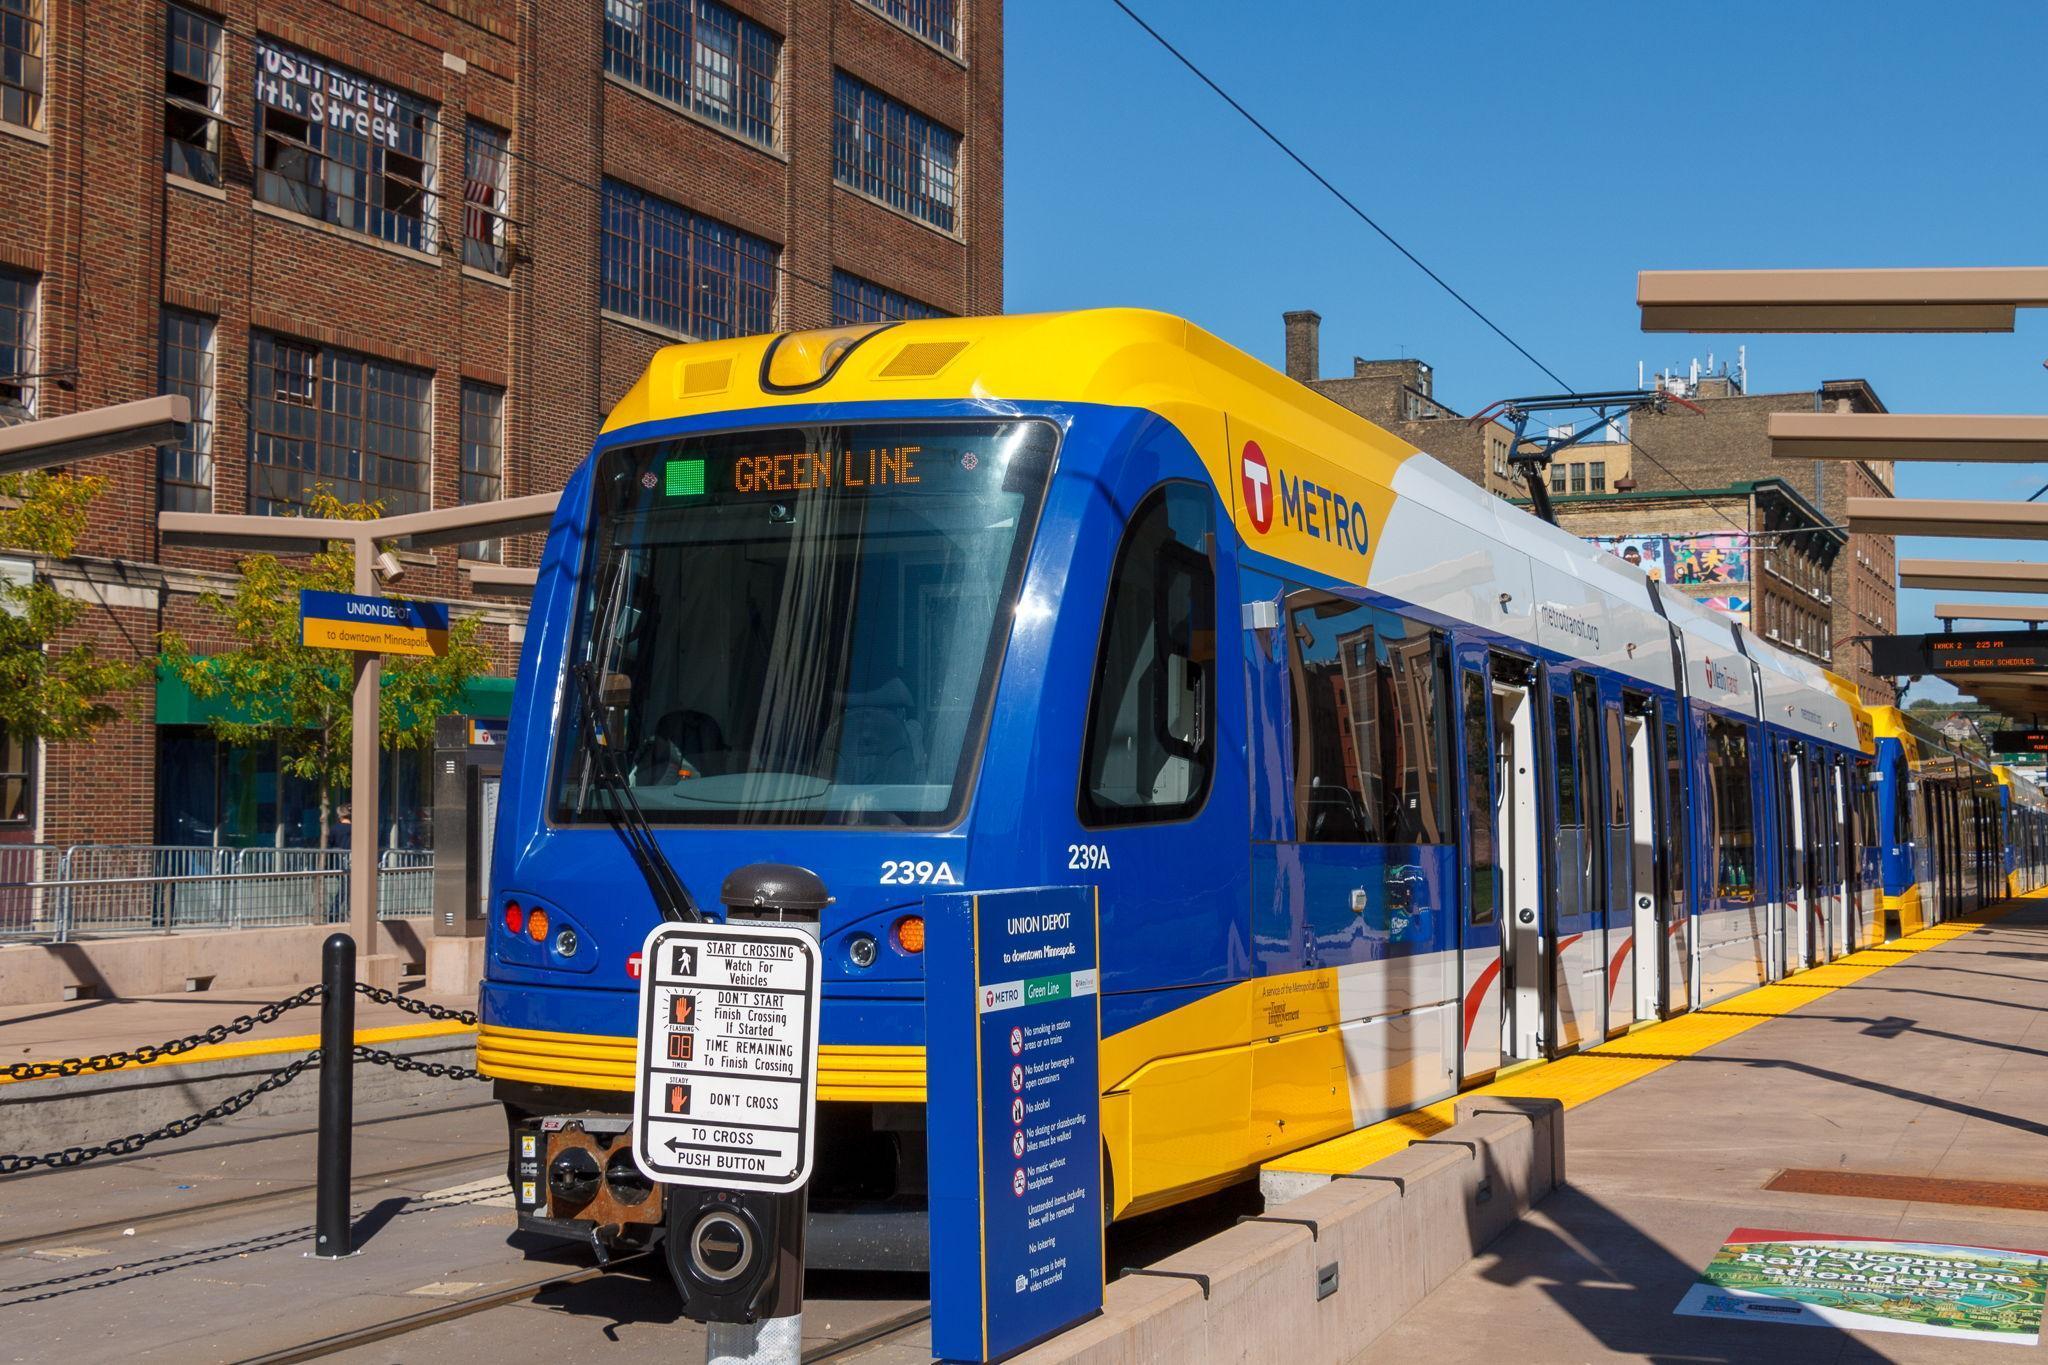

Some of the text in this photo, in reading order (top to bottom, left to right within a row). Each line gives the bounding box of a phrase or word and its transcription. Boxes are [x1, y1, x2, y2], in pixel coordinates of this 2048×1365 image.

[311, 92, 399, 148] Street
[735, 446, 921, 492] GREEN LINE
[1279, 468, 1369, 556] METRO
[347, 602, 411, 620] UNION DEPOT
[1541, 605, 1600, 650] metrotransit.org
[327, 630, 429, 651] to downtown Minneapolis
[1068, 844, 1111, 870] 239A
[880, 860, 956, 885] 239A
[1007, 912, 1071, 935] UNION DEPOT
[706, 941, 794, 959] START CROSSING
[1003, 942, 1076, 963] to downtown Minneapolis
[725, 958, 774, 973] Watch For
[730, 972, 768, 986] Vehicles
[718, 991, 785, 1007] DON'T START
[995, 989, 1019, 1003] METRO
[1028, 983, 1046, 999] Green
[1047, 981, 1059, 996] Line
[714, 1007, 787, 1026] Finish Crossing
[669, 1024, 694, 1032] FLASHING
[726, 1023, 774, 1037] If Started
[1024, 1019, 1071, 1037] No smoking in station
[669, 1034, 692, 1059] 08
[706, 1038, 793, 1057] TIME REMAINING
[1024, 1034, 1063, 1050] areas or on trains
[672, 1061, 687, 1069] TIMER
[704, 1054, 794, 1075] To Finish Crossing
[1025, 1055, 1075, 1075] No food or beverage in
[669, 1076, 689, 1084] STEADY
[1025, 1073, 1060, 1091] open containers
[710, 1093, 779, 1110] DON'T CROSS
[1025, 1098, 1051, 1114] No alcohol
[691, 1128, 754, 1145] TO CROSS
[1026, 1128, 1035, 1138] No
[1035, 1124, 1050, 1136] skating
[1051, 1122, 1056, 1130] or
[1027, 1130, 1072, 1152] bikes must be walked
[678, 1152, 765, 1171] PUSH BUTTON
[1027, 1157, 1066, 1177] No music without
[1027, 1175, 1054, 1190] headphones
[1028, 1198, 1054, 1215] Unattended
[1066, 1188, 1085, 1202] including
[1041, 1212, 1049, 1224] will
[1049, 1210, 1056, 1221] be
[1055, 1204, 1075, 1218] removed
[1028, 1236, 1056, 1254] No loitering
[1789, 1246, 1978, 1270] Welcome
[1029, 1257, 1066, 1279] This area is being
[1030, 1270, 1062, 1292] video recorded
[1762, 1266, 1987, 1292] attendees!
